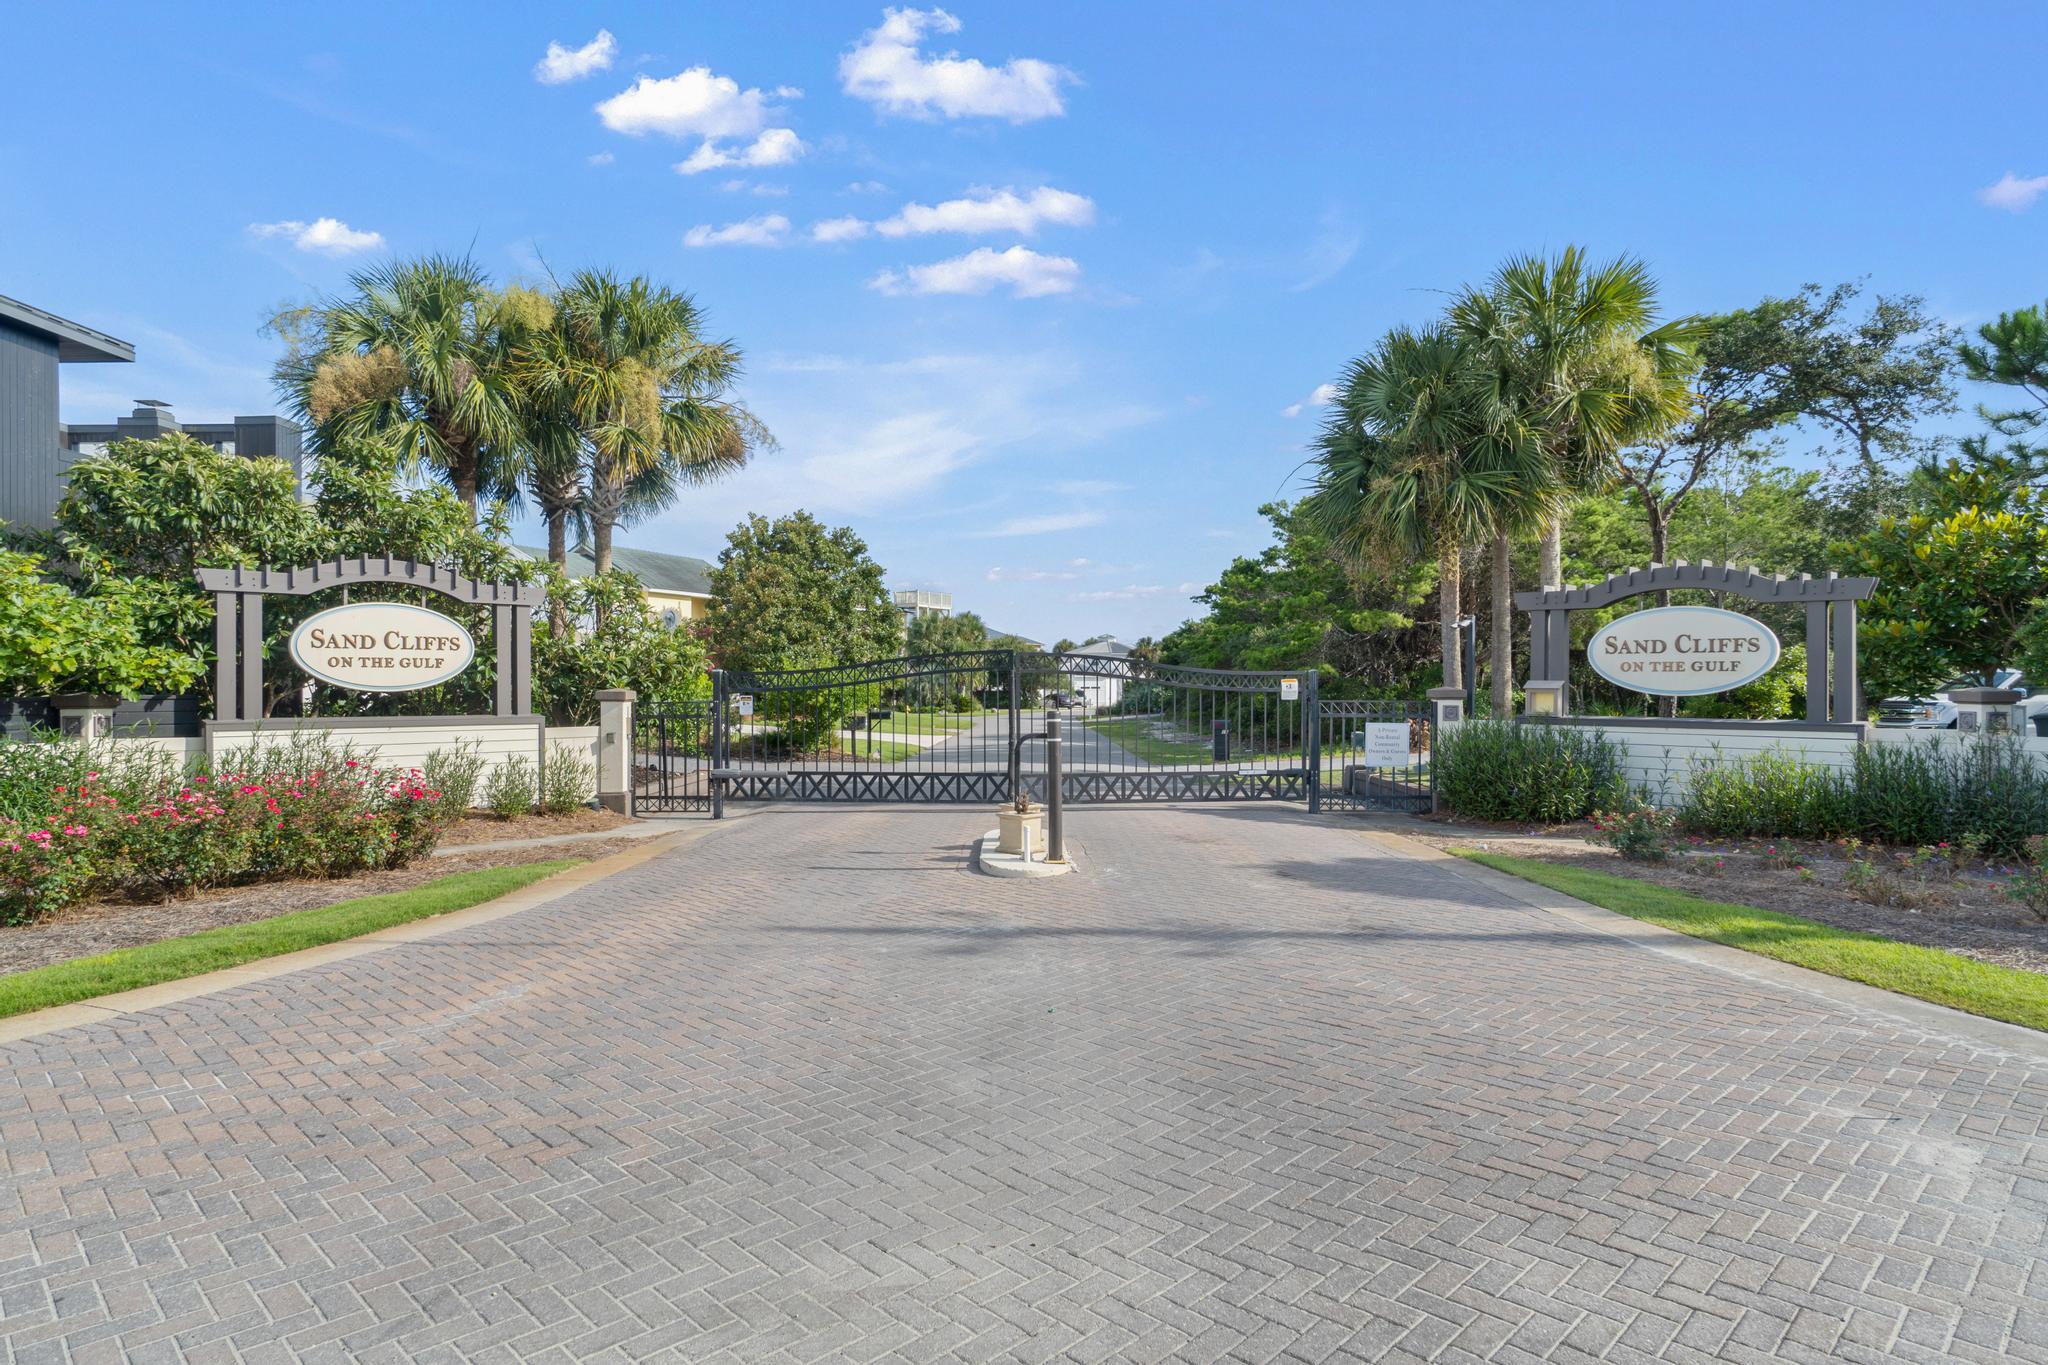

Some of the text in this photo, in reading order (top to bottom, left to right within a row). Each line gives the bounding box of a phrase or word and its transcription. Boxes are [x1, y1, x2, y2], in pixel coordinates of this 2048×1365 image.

[311, 628, 461, 651] SAND CLIFFS
[1605, 634, 1760, 655] SAND CLIFFS
[327, 656, 445, 669] ON THE GULF
[1620, 660, 1741, 672] ON THE GULF
